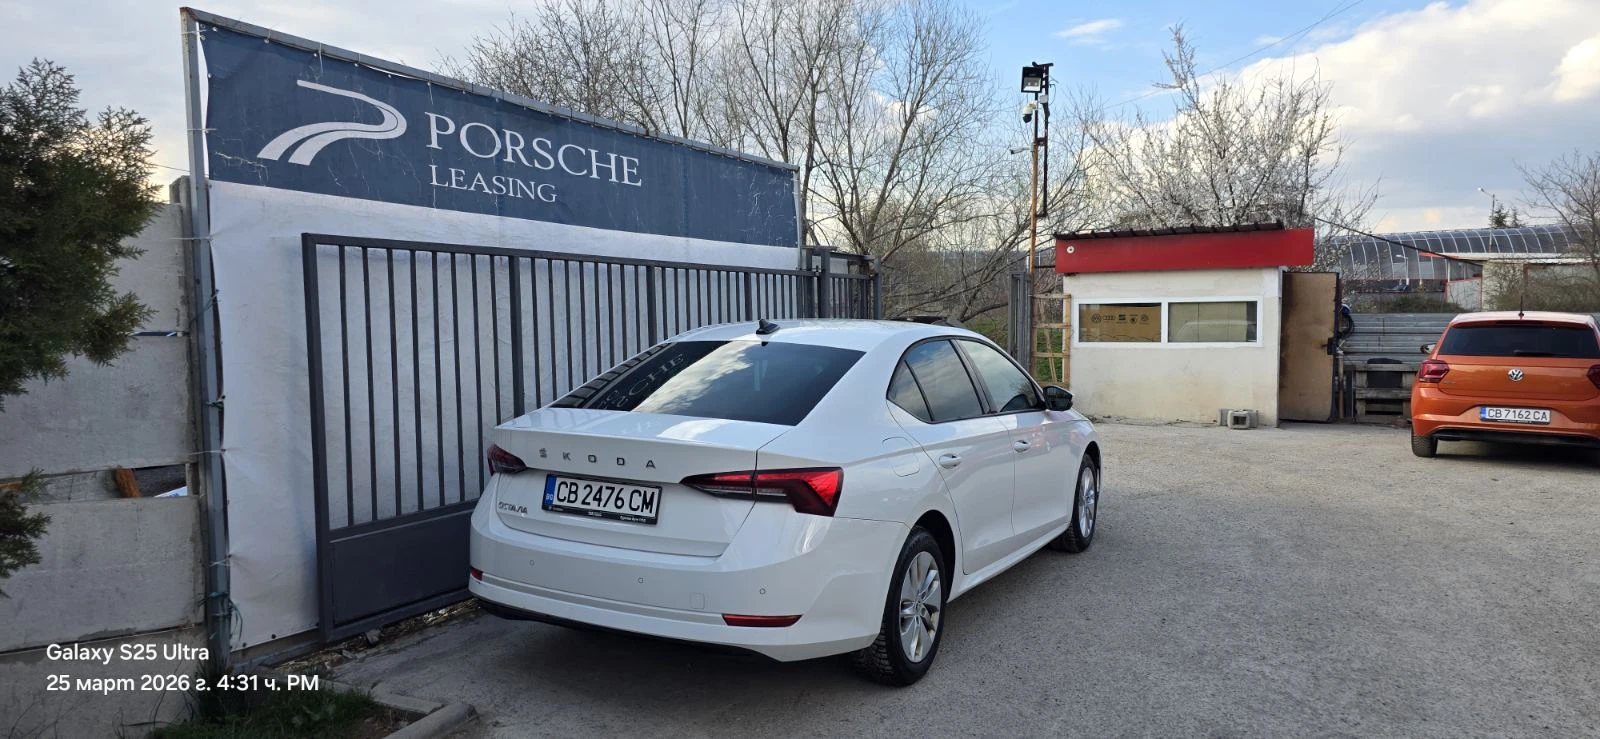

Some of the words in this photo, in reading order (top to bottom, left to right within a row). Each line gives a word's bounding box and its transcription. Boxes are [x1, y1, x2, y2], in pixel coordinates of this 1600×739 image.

[425, 112, 643, 187] PORSCHE
[428, 164, 558, 204] LEASING
[1488, 409, 1502, 418] CB
[1504, 410, 1531, 420] 7162
[1533, 411, 1547, 421] CA
[556, 480, 579, 504] CB
[581, 484, 625, 510] 2476
[629, 489, 655, 514] CM
